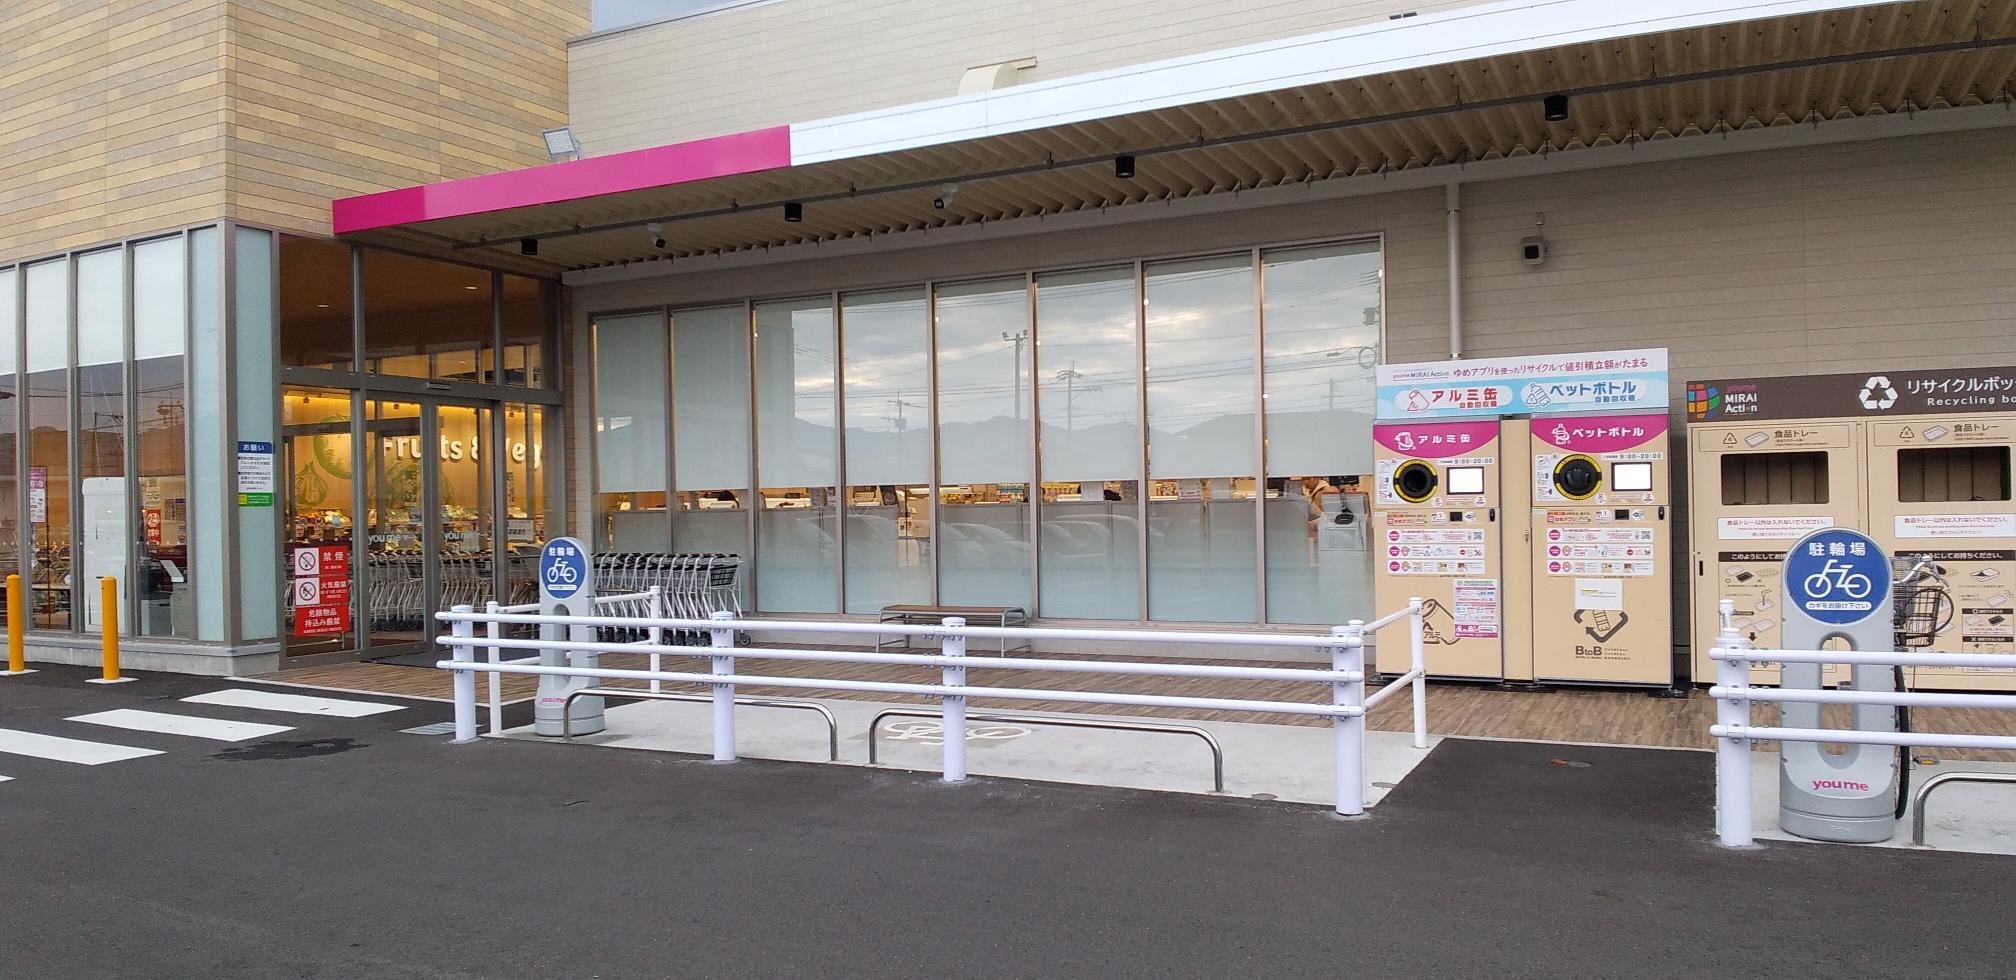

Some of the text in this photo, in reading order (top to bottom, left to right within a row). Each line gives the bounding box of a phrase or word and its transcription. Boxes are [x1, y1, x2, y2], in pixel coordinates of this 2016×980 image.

[1550, 381, 1637, 396] ペットボトル
[1907, 375, 2016, 394] リサイクルボッ
[1432, 388, 1498, 402] アルミ缶
[1725, 393, 1758, 404] MIRAI
[1927, 395, 1995, 406] Recycling
[1572, 427, 1644, 438] ペットボトル
[1774, 429, 1818, 439] 食品トレー
[1954, 424, 2000, 433] 食品トレー
[1418, 433, 1471, 444] アルミ缶
[383, 434, 463, 461] Fruts
[549, 547, 575, 556] 駐輪場
[1808, 542, 1867, 556] 駐輪場
[321, 581, 347, 589] 火気厳禁
